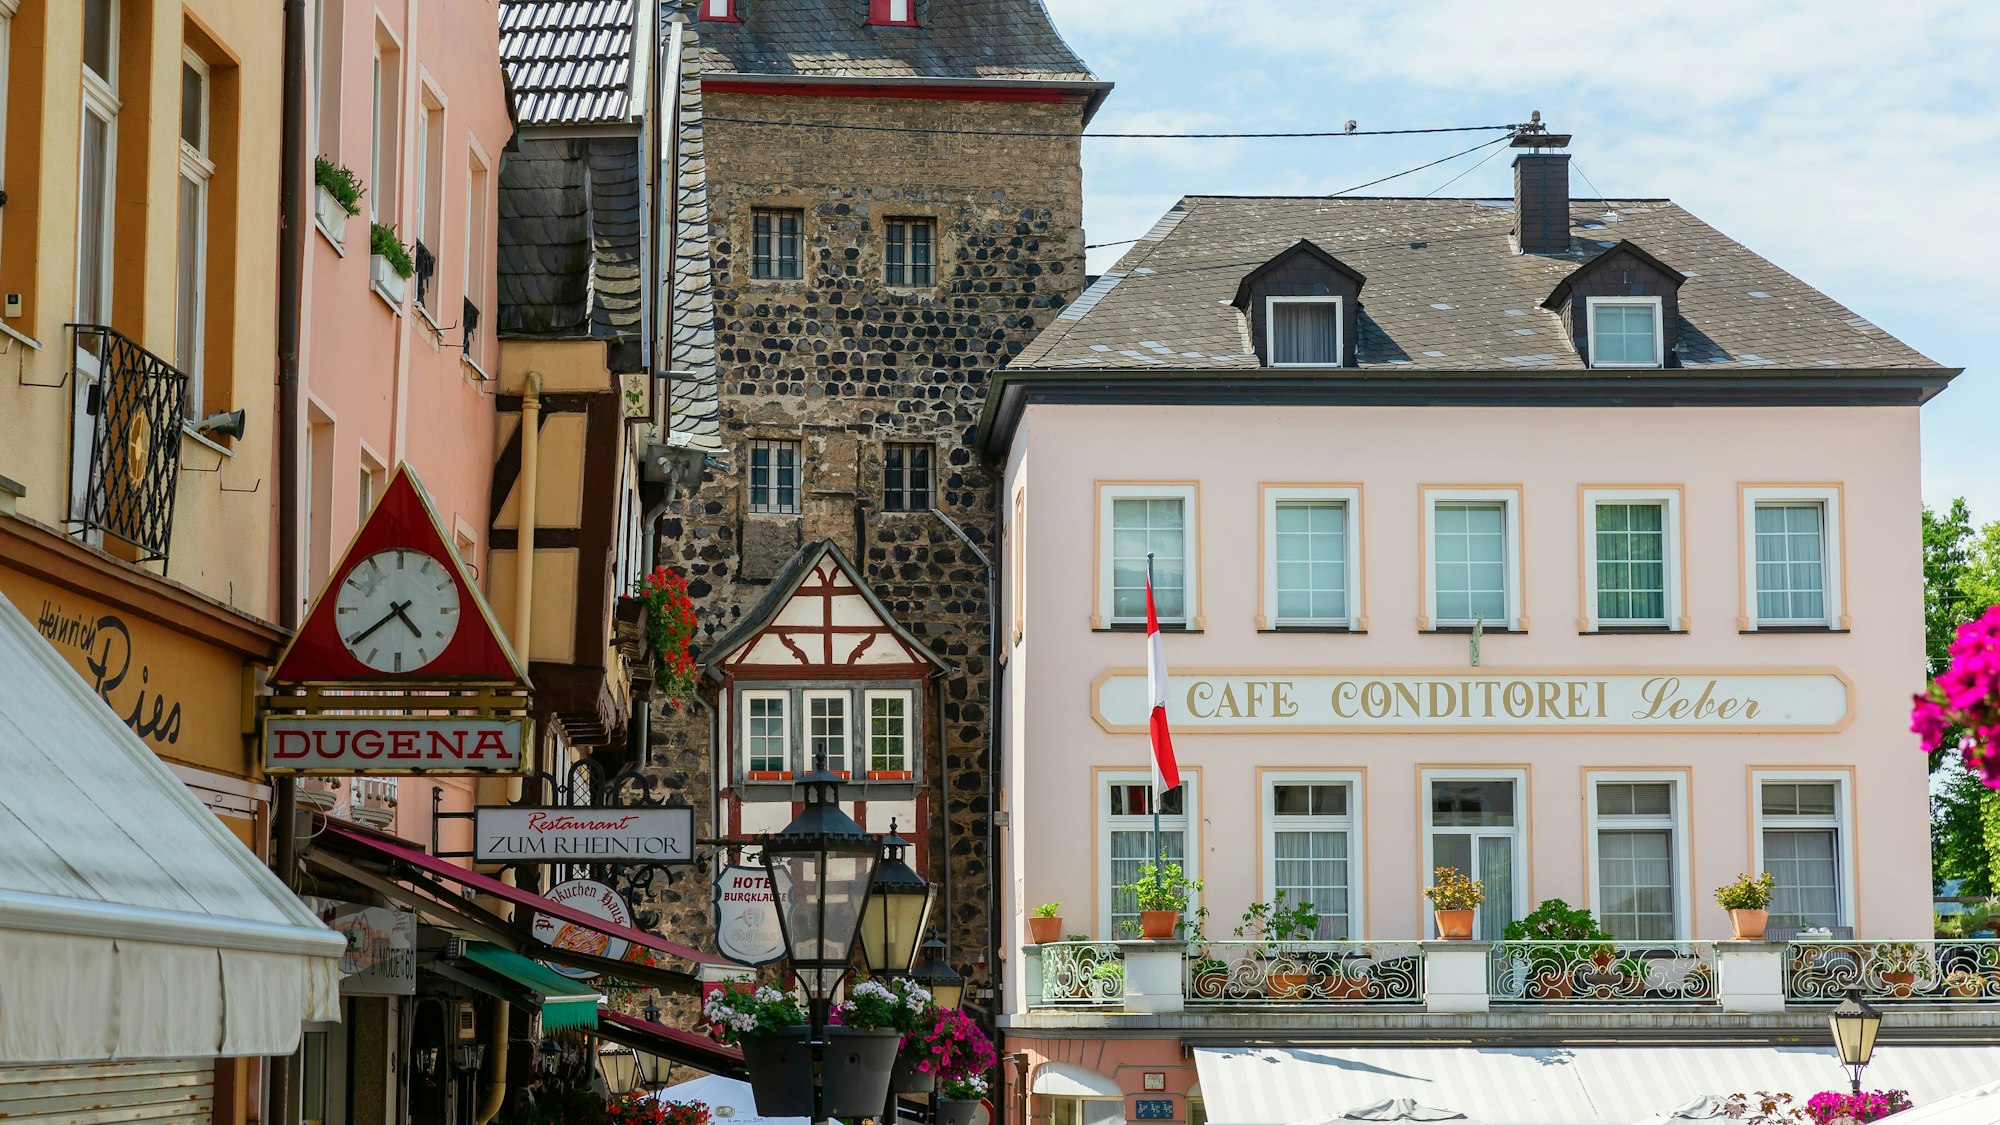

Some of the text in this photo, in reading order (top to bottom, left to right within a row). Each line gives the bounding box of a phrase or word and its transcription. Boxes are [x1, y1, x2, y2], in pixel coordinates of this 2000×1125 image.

[38, 599, 97, 655] Heinrich
[87, 615, 181, 744] Ries
[1186, 677, 1761, 720] CAFE CONDITOREI Leber
[273, 729, 513, 760] DUGENA
[528, 811, 639, 835] Restaurant
[488, 836, 682, 854] ZUM RHEINTOR
[724, 892, 787, 903] BURGKLAUE
[733, 877, 774, 889] HOTE
[535, 881, 627, 932] Pnkuchen Haus
